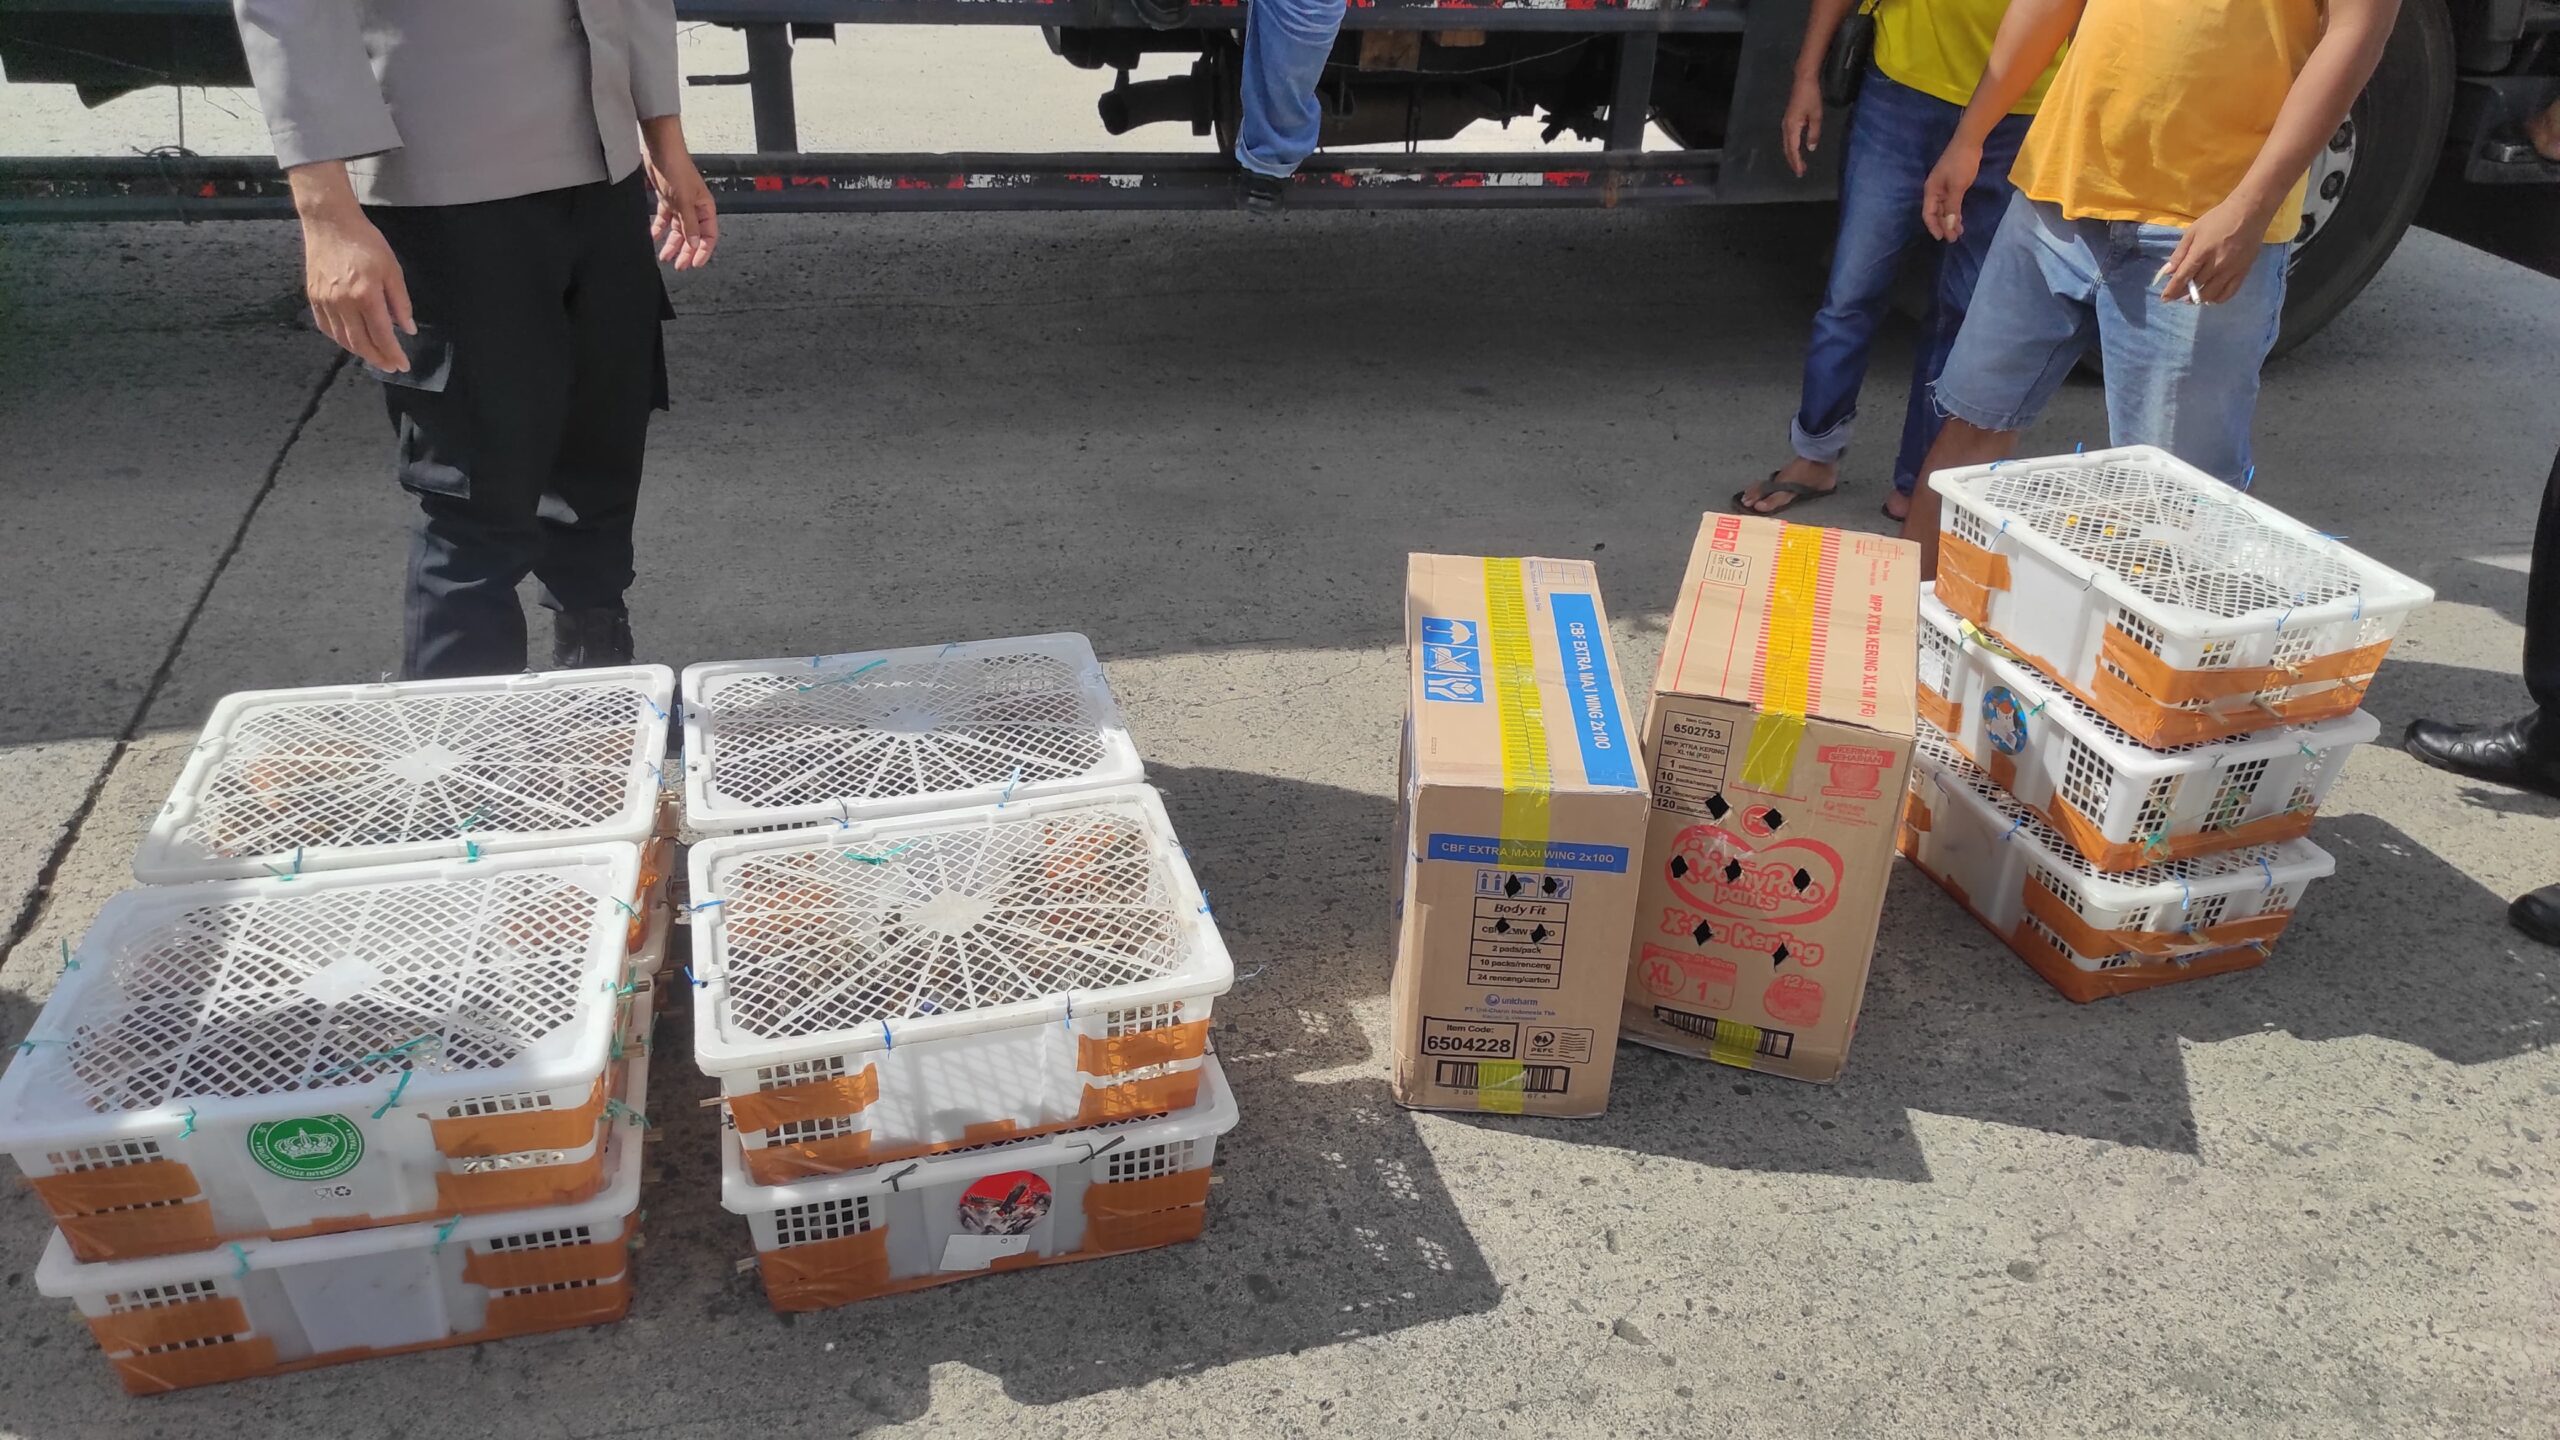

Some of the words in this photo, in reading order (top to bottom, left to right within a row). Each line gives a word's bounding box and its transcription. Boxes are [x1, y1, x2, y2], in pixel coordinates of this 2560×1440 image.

[1869, 594, 1883, 612] MPP
[1569, 622, 1587, 639] CBF
[1866, 613, 1882, 636] XTRA
[1573, 640, 1592, 670] EXTRA
[1863, 637, 1880, 672] KERING
[1861, 673, 1877, 699] XL1M
[1584, 693, 1605, 719] WING
[1857, 699, 1876, 718] (FG)
[1673, 724, 1721, 740] 6502753
[1680, 742, 1698, 751] XTRA
[1699, 745, 1726, 756] KERING
[1669, 759, 1676, 769] 1
[1660, 771, 1674, 781] 10
[1658, 784, 1672, 795] 12
[1656, 798, 1676, 809] 120
[1441, 842, 1466, 854] CBF
[1468, 844, 1508, 857] EXTRA
[1511, 848, 1541, 859] MAXI
[1544, 849, 1576, 862] WING
[1714, 884, 1779, 911] pants
[1494, 903, 1528, 916] Body
[1529, 904, 1547, 916] Fit
[1492, 945, 1497, 953] 2
[1498, 946, 1542, 955] pads/pack
[1480, 958, 1490, 967] 10
[1491, 960, 1551, 970] packs/renceng
[1477, 973, 1487, 981] 24
[1489, 975, 1551, 985] renceng/carton
[1650, 961, 1673, 985] XL
[1783, 975, 1801, 987] 12
[1696, 982, 1708, 1001] 1
[1446, 1024, 1465, 1033] Item
[1468, 1025, 1495, 1034] Code:
[1427, 1035, 1511, 1054] 6504228
